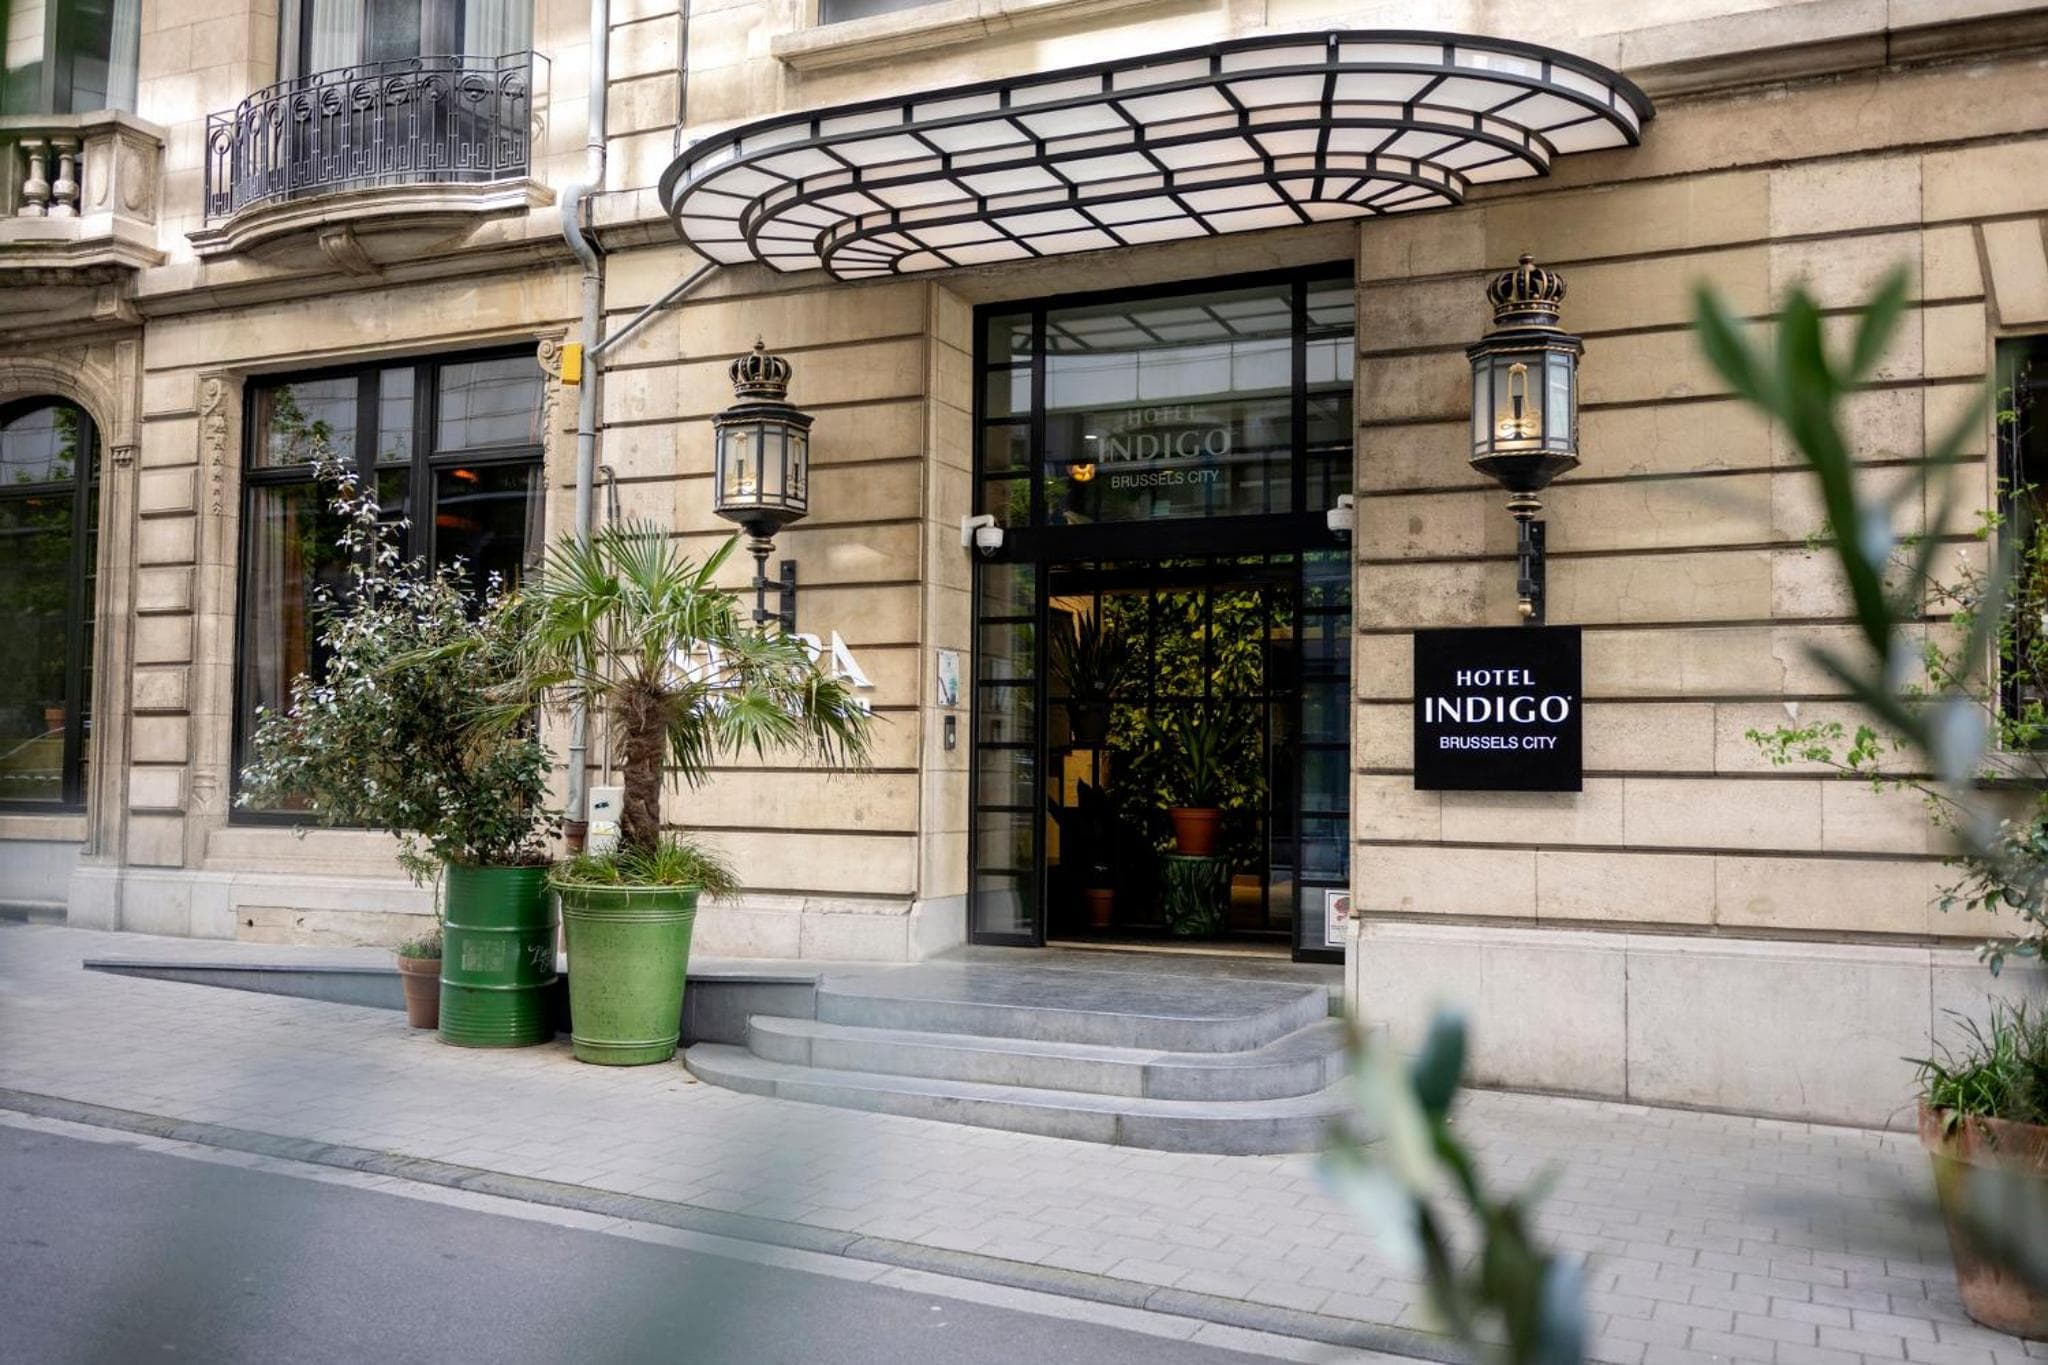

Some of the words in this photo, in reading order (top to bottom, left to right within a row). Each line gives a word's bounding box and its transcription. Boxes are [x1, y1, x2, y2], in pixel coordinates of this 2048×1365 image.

[1128, 405, 1204, 426] HOTEL
[1099, 428, 1232, 464] INDIGO
[1112, 471, 1184, 489] BRUSSELS
[1187, 469, 1221, 485] CITY
[1456, 669, 1536, 687] HOTEL
[1425, 695, 1570, 723] INDIGO
[1439, 735, 1519, 750] BRUSSELS
[1522, 735, 1557, 749] CITY
